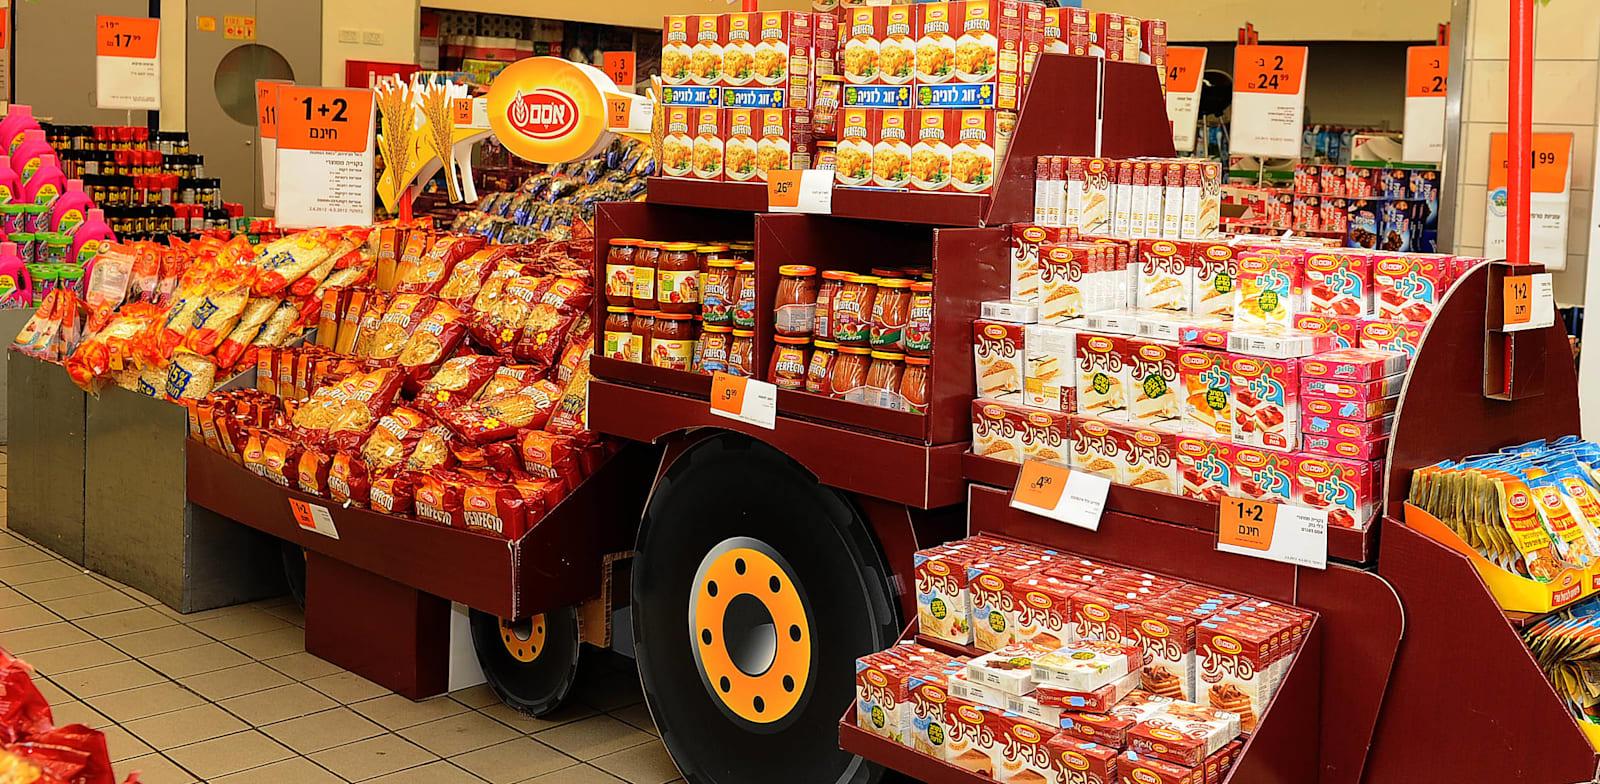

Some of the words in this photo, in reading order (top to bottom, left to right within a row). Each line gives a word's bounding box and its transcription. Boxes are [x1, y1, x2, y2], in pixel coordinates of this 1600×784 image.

[852, 24, 874, 36] PERFECTO
[887, 24, 910, 34] PERFECTO
[924, 21, 949, 33] PERFECTO
[964, 18, 990, 32] PERFECTO
[1274, 56, 1284, 71] 2
[883, 91, 896, 103] זוג
[962, 90, 976, 102] זוג
[302, 97, 348, 122] 1+2
[530, 102, 566, 128] אסם
[310, 128, 338, 139] חינם
[844, 126, 867, 137] PERFECTO
[881, 127, 905, 139] PERFECTO
[920, 127, 945, 139] PERFECTO
[960, 128, 986, 140] PERFECTO
[1041, 258, 1082, 282] פודינג
[1143, 252, 1184, 277] פודינג
[978, 334, 1016, 358] פודינג
[1080, 348, 1122, 374] פודינג
[1132, 356, 1176, 382] פודינג
[1249, 374, 1284, 408] ג'לי
[976, 414, 1016, 438] פודינג
[1022, 421, 1061, 447] פודינג
[1075, 430, 1118, 456] פודינג
[1126, 440, 1170, 468] פודינג
[1194, 453, 1230, 488] ג'לי
[1253, 464, 1290, 499] ג'לי
[1316, 476, 1355, 511] ג'לי
[416, 500, 452, 526] PERFECTO
[464, 510, 502, 534] PERFECTO
[1238, 502, 1263, 522] 1+2
[1238, 525, 1260, 536] חינם
[920, 569, 958, 596] פודינג
[973, 583, 1014, 612] פודינג
[1018, 600, 1062, 631] פודינג
[1133, 628, 1182, 662] פודינג
[1201, 644, 1254, 680] פודינג
[860, 676, 896, 710] פודינג
[949, 713, 994, 748] פודינג
[1003, 732, 1050, 768] פודינג
